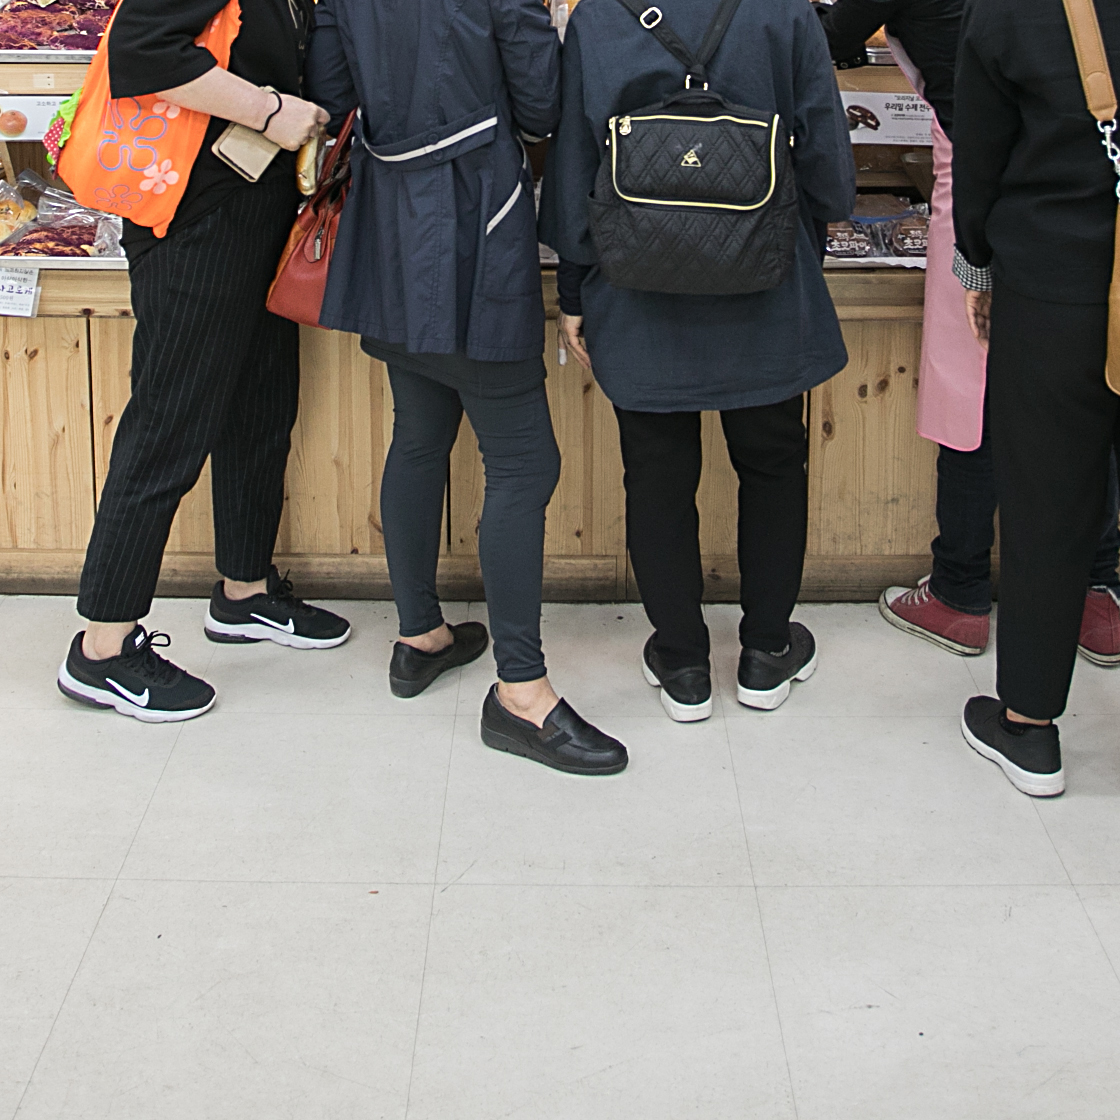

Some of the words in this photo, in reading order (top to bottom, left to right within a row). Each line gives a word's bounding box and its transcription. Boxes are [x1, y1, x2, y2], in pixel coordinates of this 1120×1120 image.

[884, 102, 904, 112] 우리밀
[905, 103, 918, 112] 수제
[830, 240, 868, 251] 초코파이
